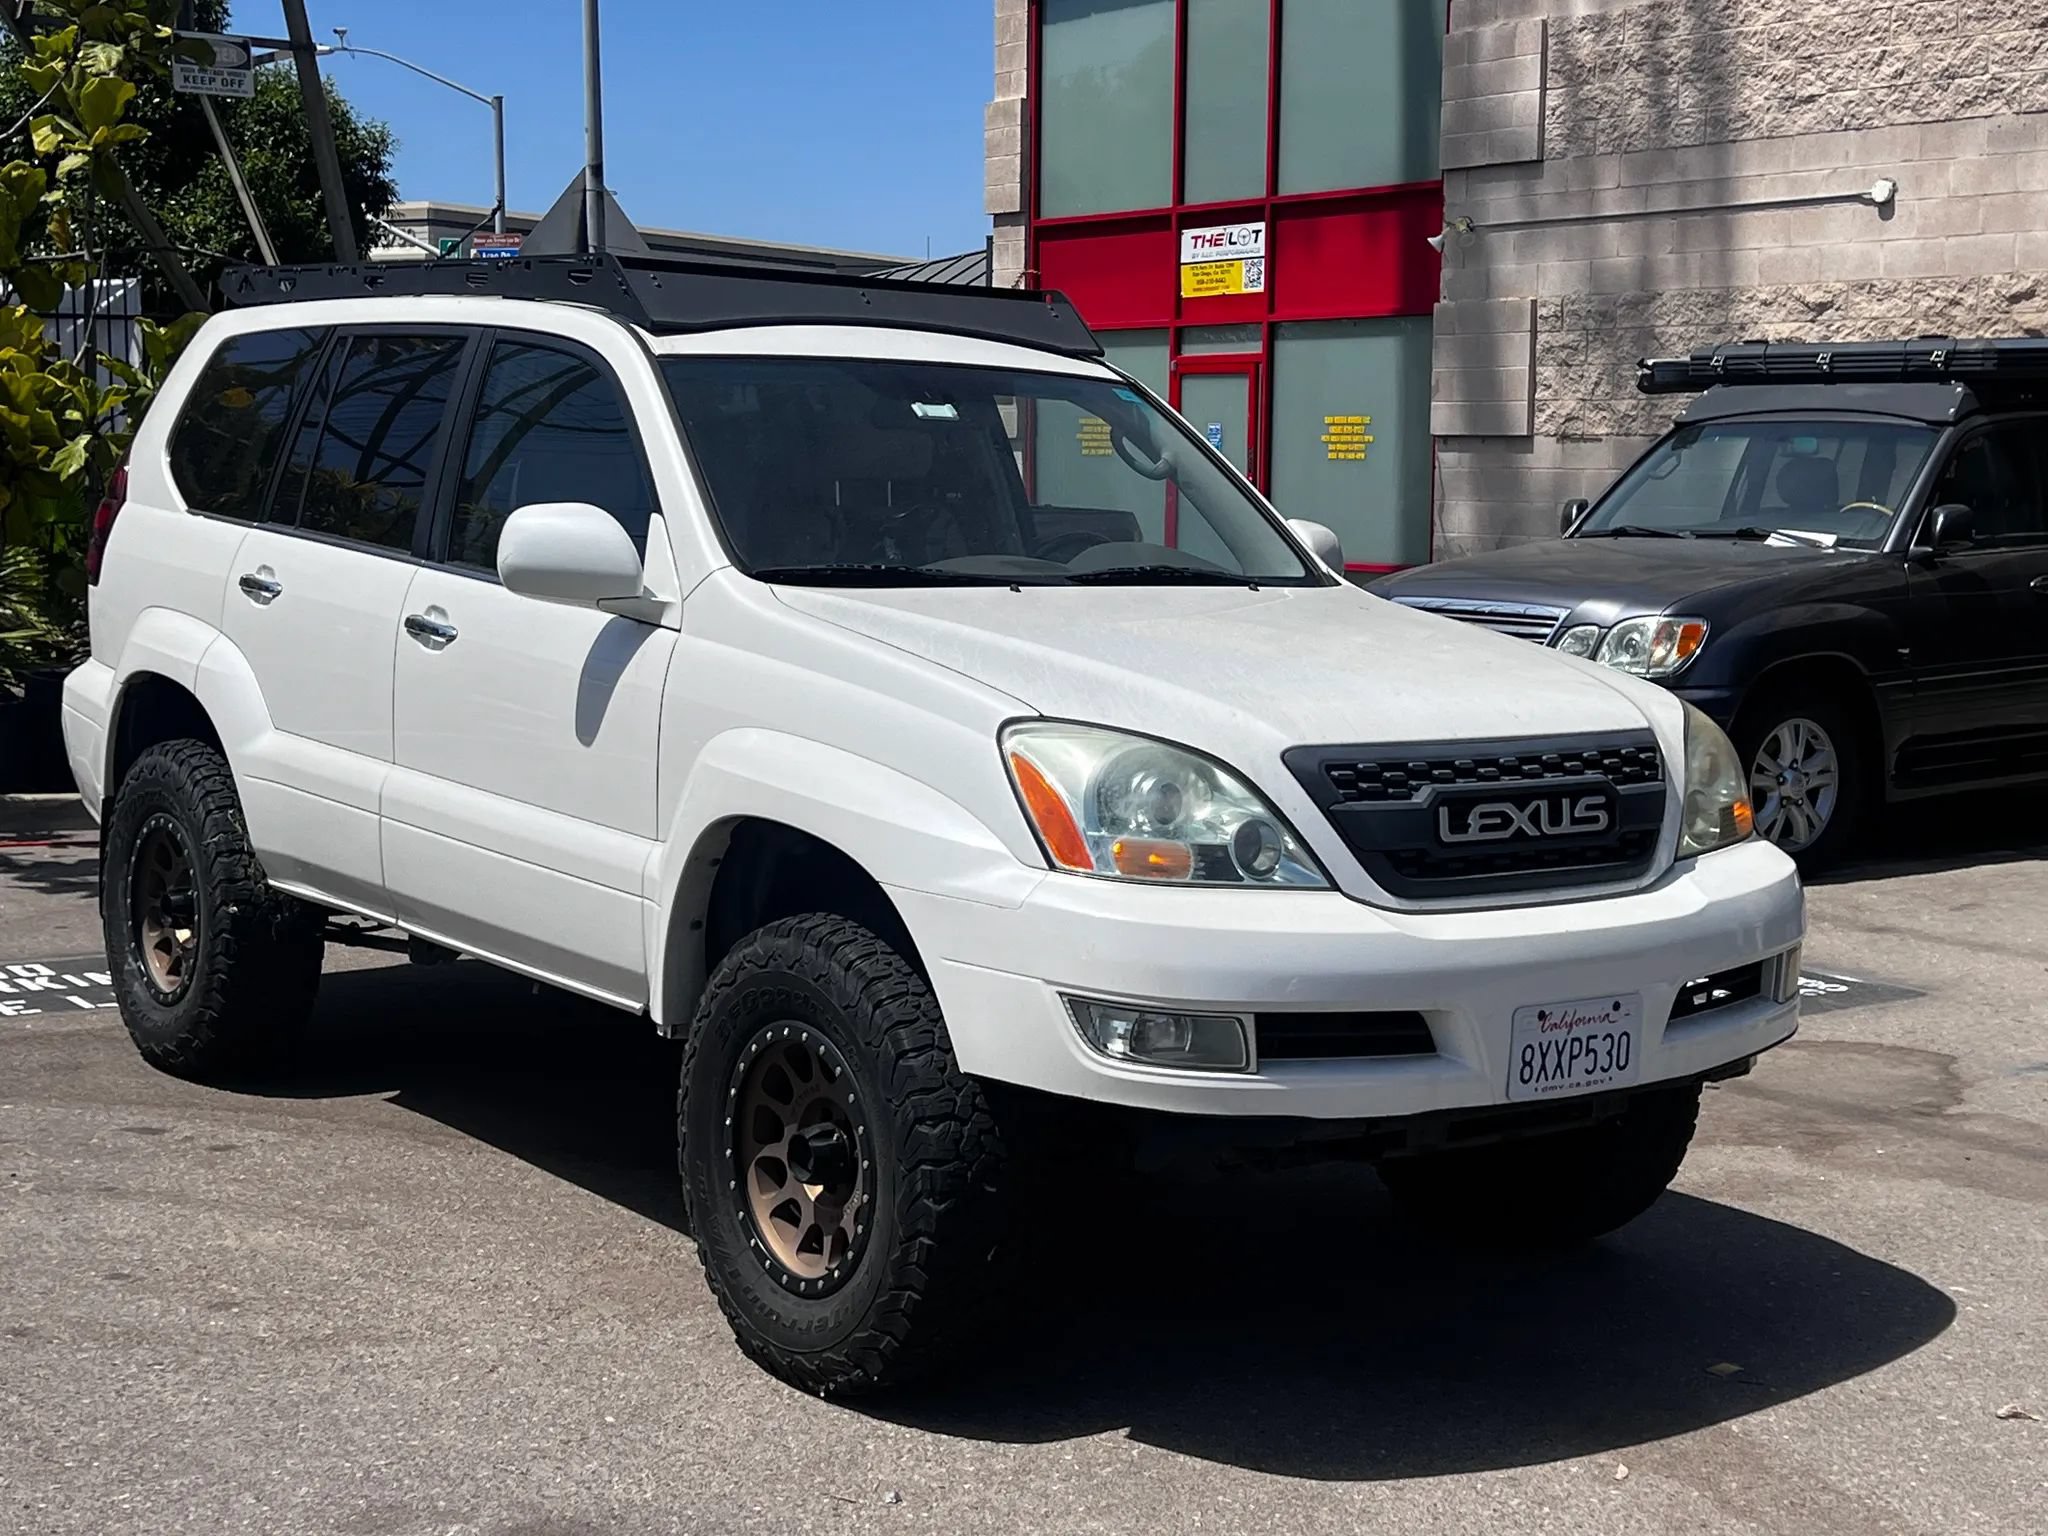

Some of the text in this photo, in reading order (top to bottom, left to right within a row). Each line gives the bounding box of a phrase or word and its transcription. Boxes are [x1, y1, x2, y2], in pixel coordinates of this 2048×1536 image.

[183, 74, 216, 86] KEEP
[221, 77, 245, 89] OFF
[1190, 233, 1225, 249] THE
[1439, 796, 1608, 843] LEXUS
[1540, 1008, 1618, 1035] California
[1519, 1030, 1631, 1084] 8XXP530
